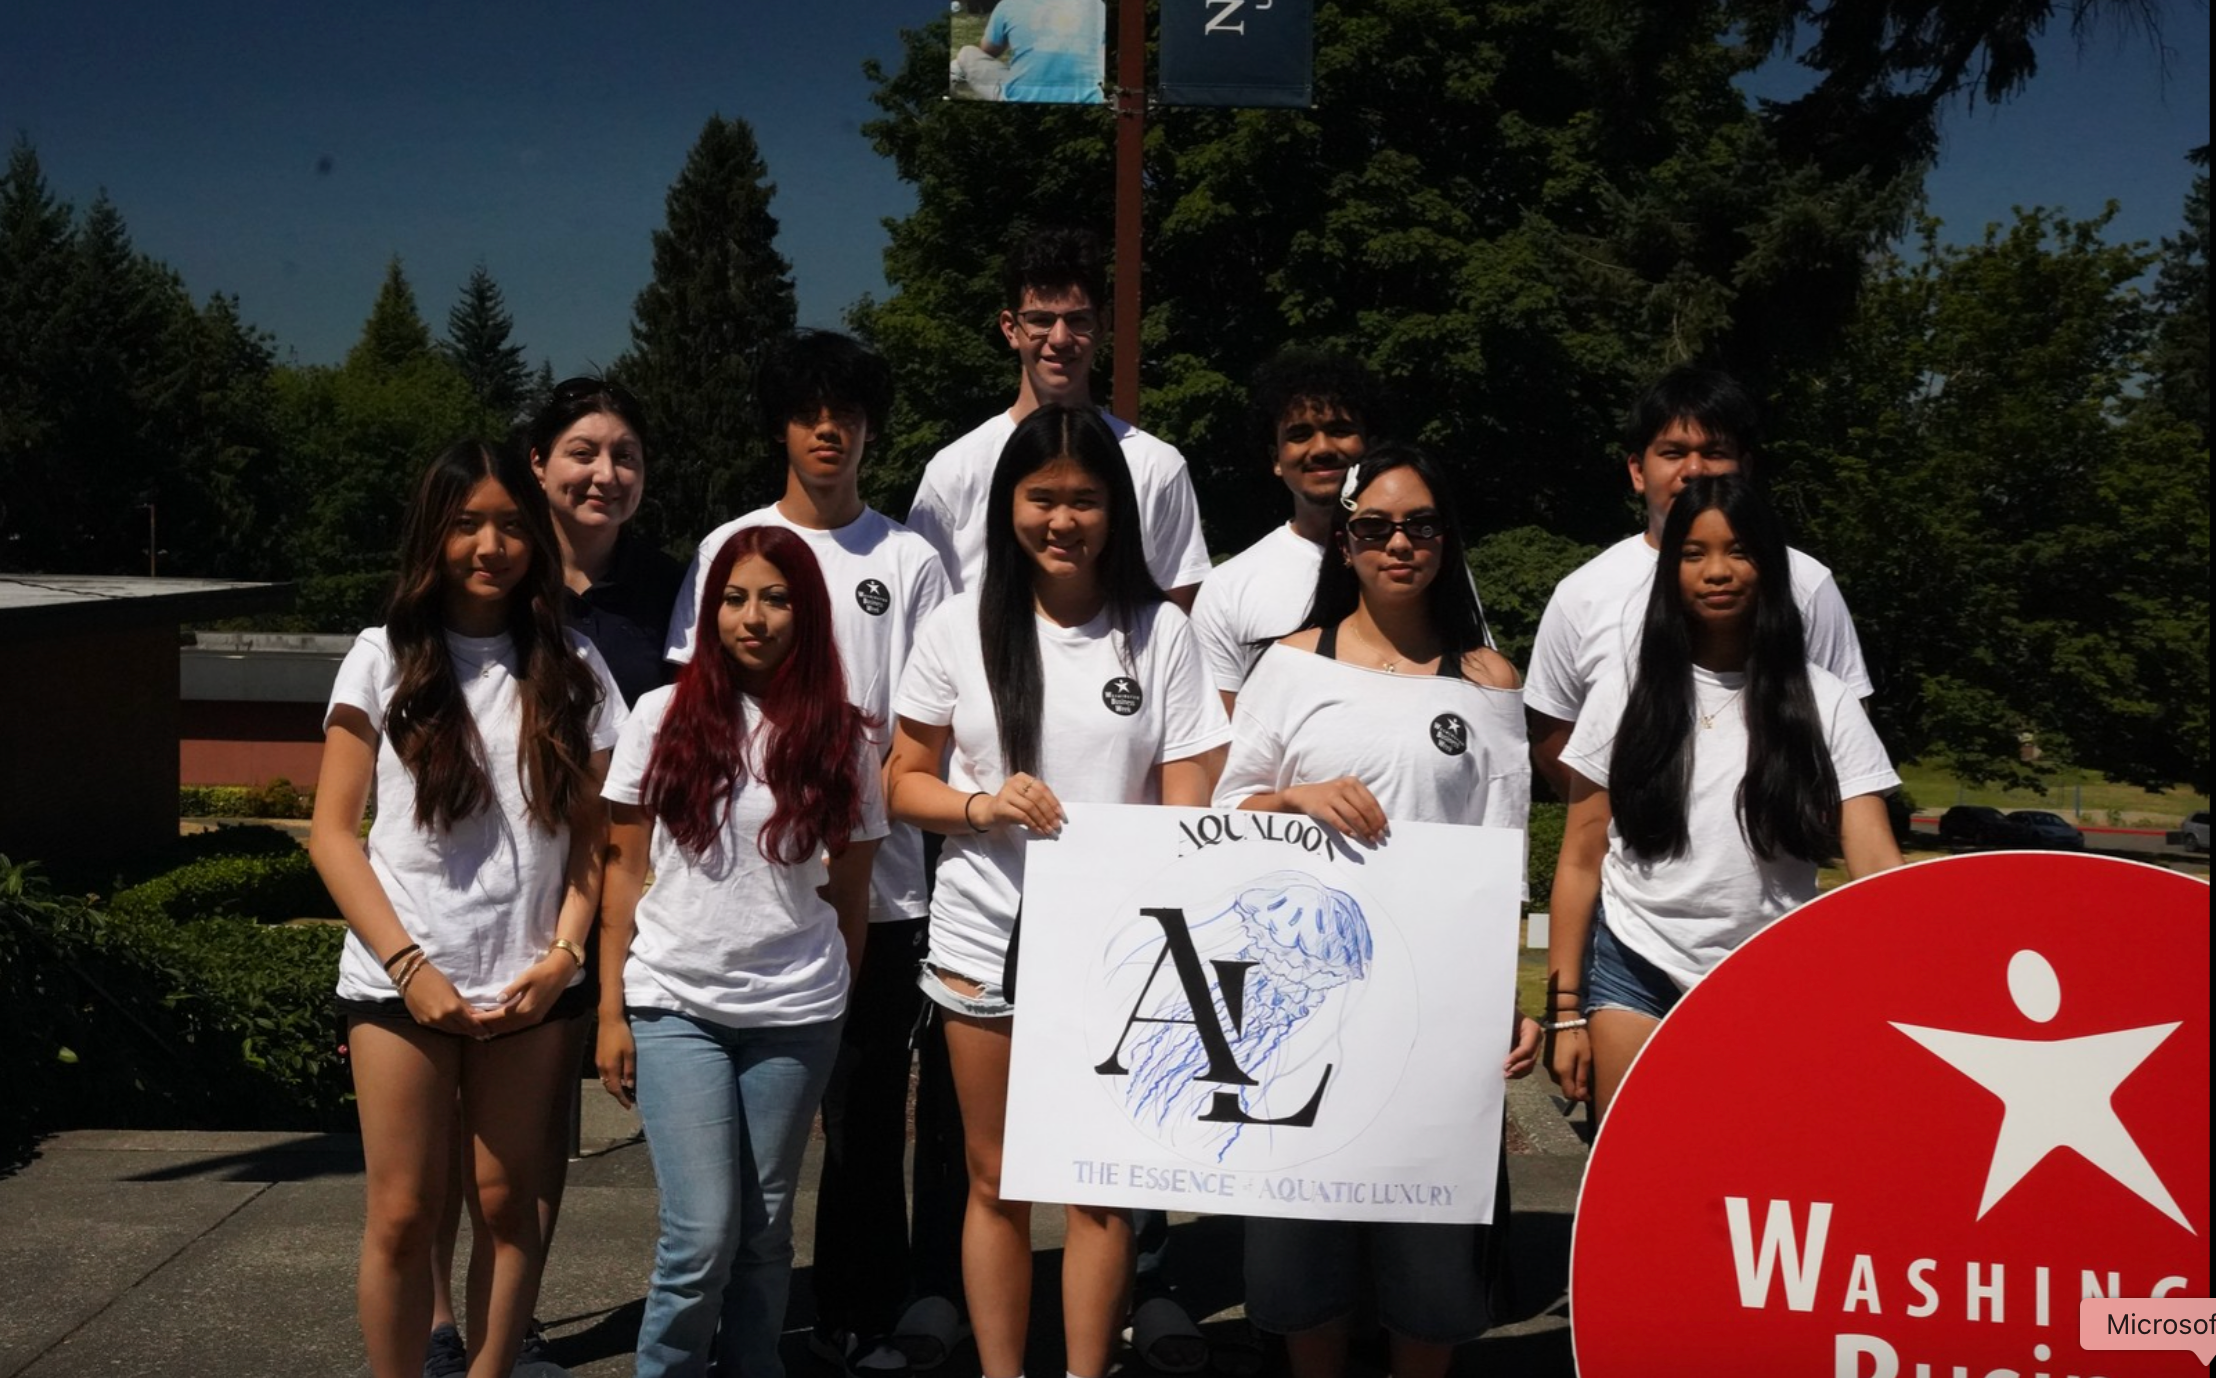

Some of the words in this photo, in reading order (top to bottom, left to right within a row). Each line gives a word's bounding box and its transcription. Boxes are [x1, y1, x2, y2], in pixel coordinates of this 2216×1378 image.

[1072, 1160, 1120, 1185] THE
[1128, 1164, 1237, 1198] ESSENCE
[1257, 1176, 1367, 1204] AQUATIC
[1371, 1181, 1459, 1207] LUXURY
